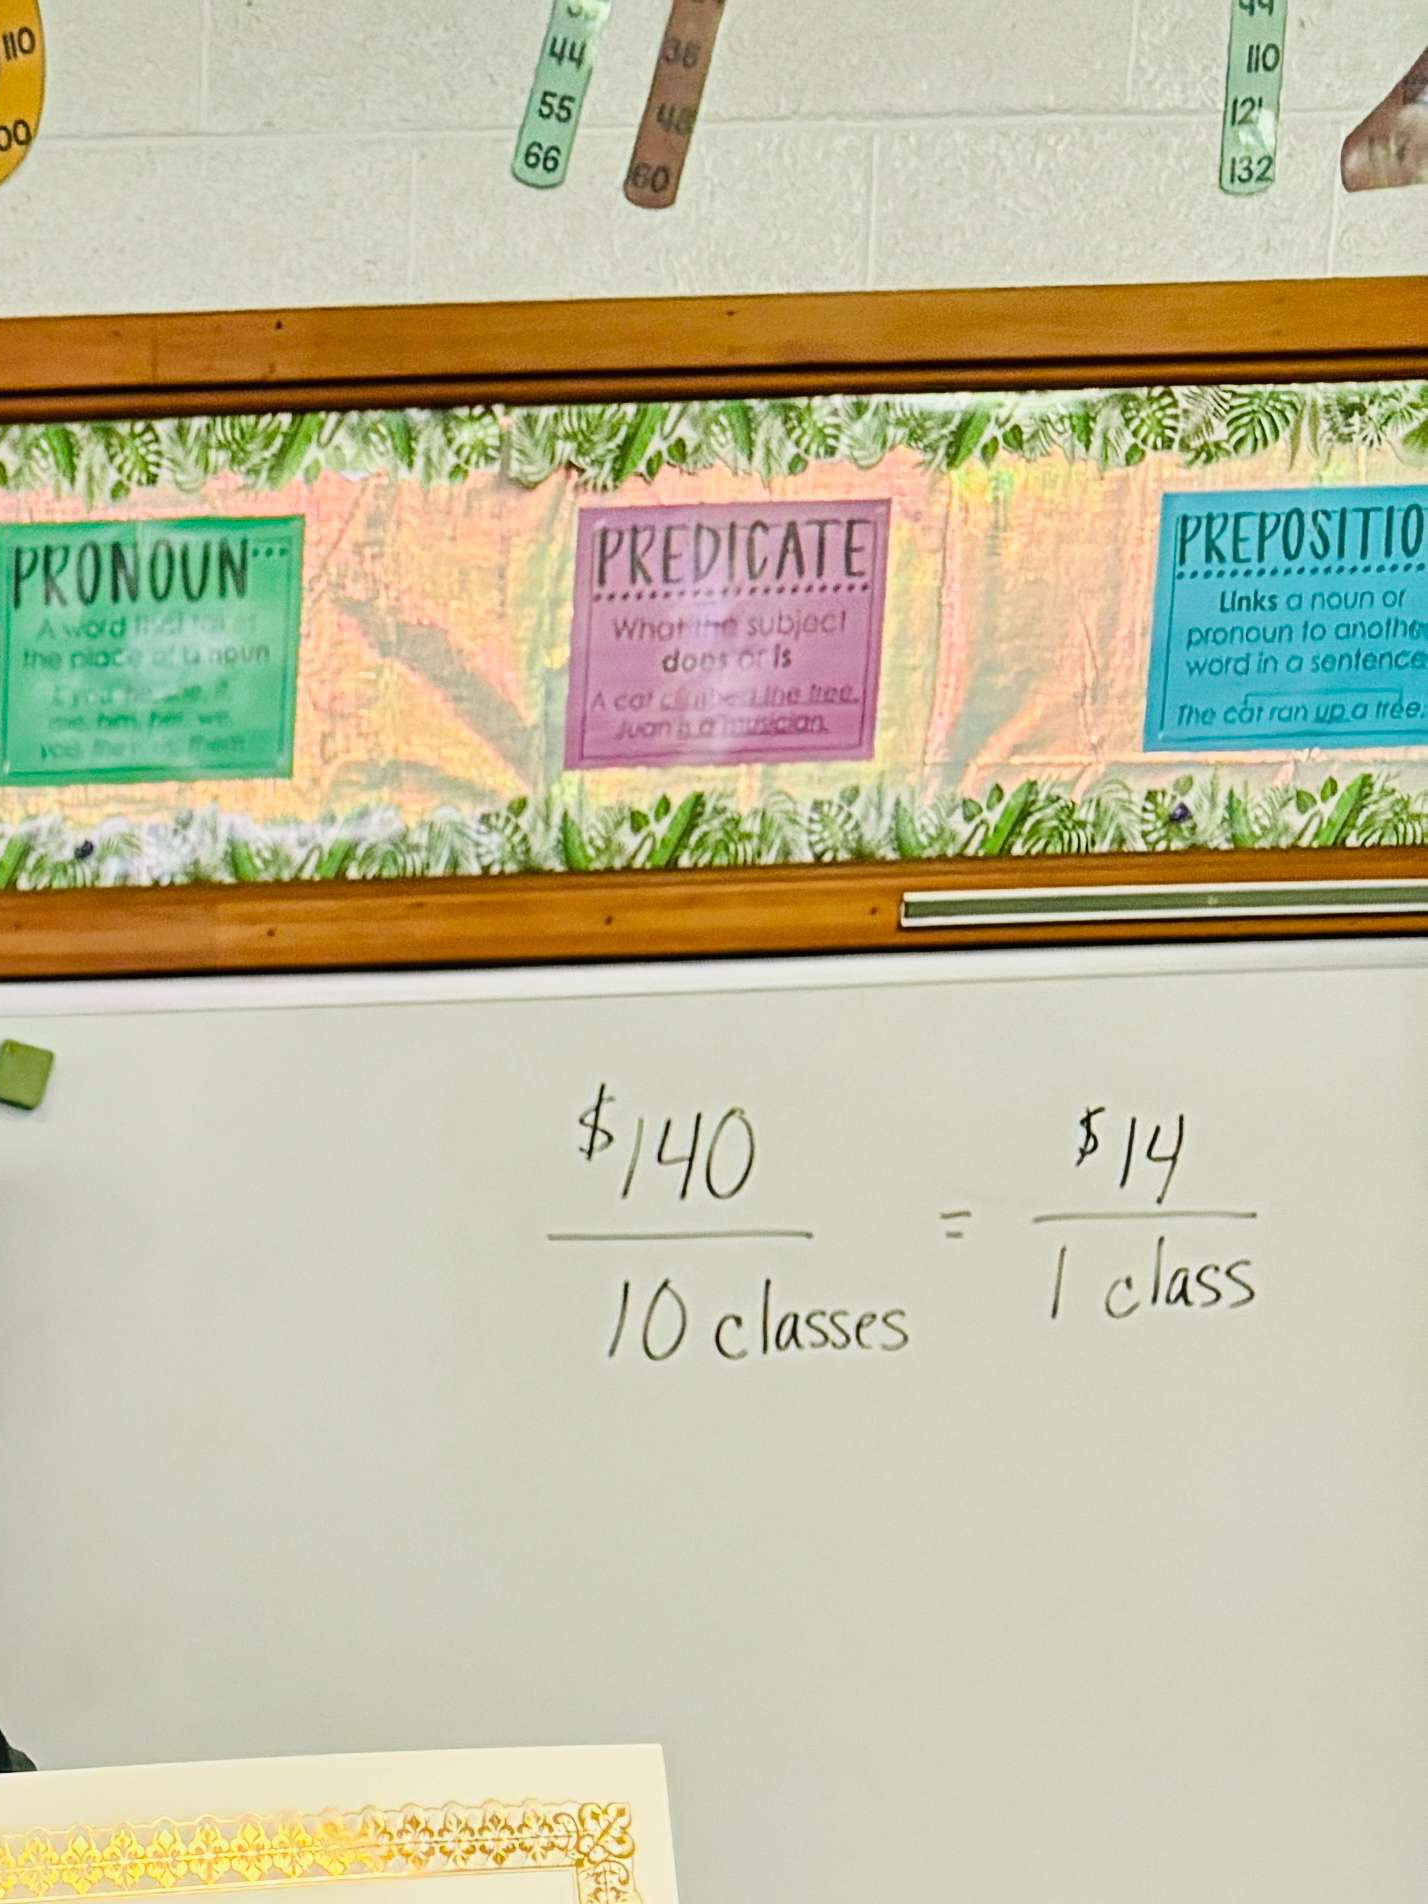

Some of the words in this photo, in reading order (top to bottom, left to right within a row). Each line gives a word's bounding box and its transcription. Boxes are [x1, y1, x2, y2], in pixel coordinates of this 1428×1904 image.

[3, 27, 36, 61] 110
[549, 36, 587, 69] 44
[1247, 43, 1280, 73] 110
[538, 90, 575, 123] 55
[524, 141, 561, 173] 66
[1230, 156, 1273, 184] 132
[597, 518, 871, 587] PREDICATE
[11, 537, 249, 610] PRONOUN
[1219, 589, 1278, 614] Links
[1286, 594, 1303, 611] a
[1311, 591, 1374, 611] noun
[1383, 588, 1407, 609] or
[613, 616, 687, 642] What
[747, 610, 847, 641] subject
[1186, 623, 1293, 650] pronoun
[1303, 621, 1326, 642] to
[773, 644, 792, 668] is
[1186, 653, 1250, 676] word
[1257, 652, 1278, 675] in
[1286, 656, 1303, 673] a
[1311, 648, 1428, 673] sentence
[1177, 705, 1216, 726] The
[1223, 703, 1264, 724] cat
[1270, 703, 1308, 724] ran
[1314, 703, 1343, 725] up
[1351, 703, 1367, 721] a
[578, 1082, 756, 1200] $140
[1075, 1106, 1186, 1205] $14
[1051, 1244, 1068, 1319] 1
[1104, 1236, 1256, 1319] class
[607, 1278, 689, 1361] 10
[713, 1278, 911, 1358] classes
